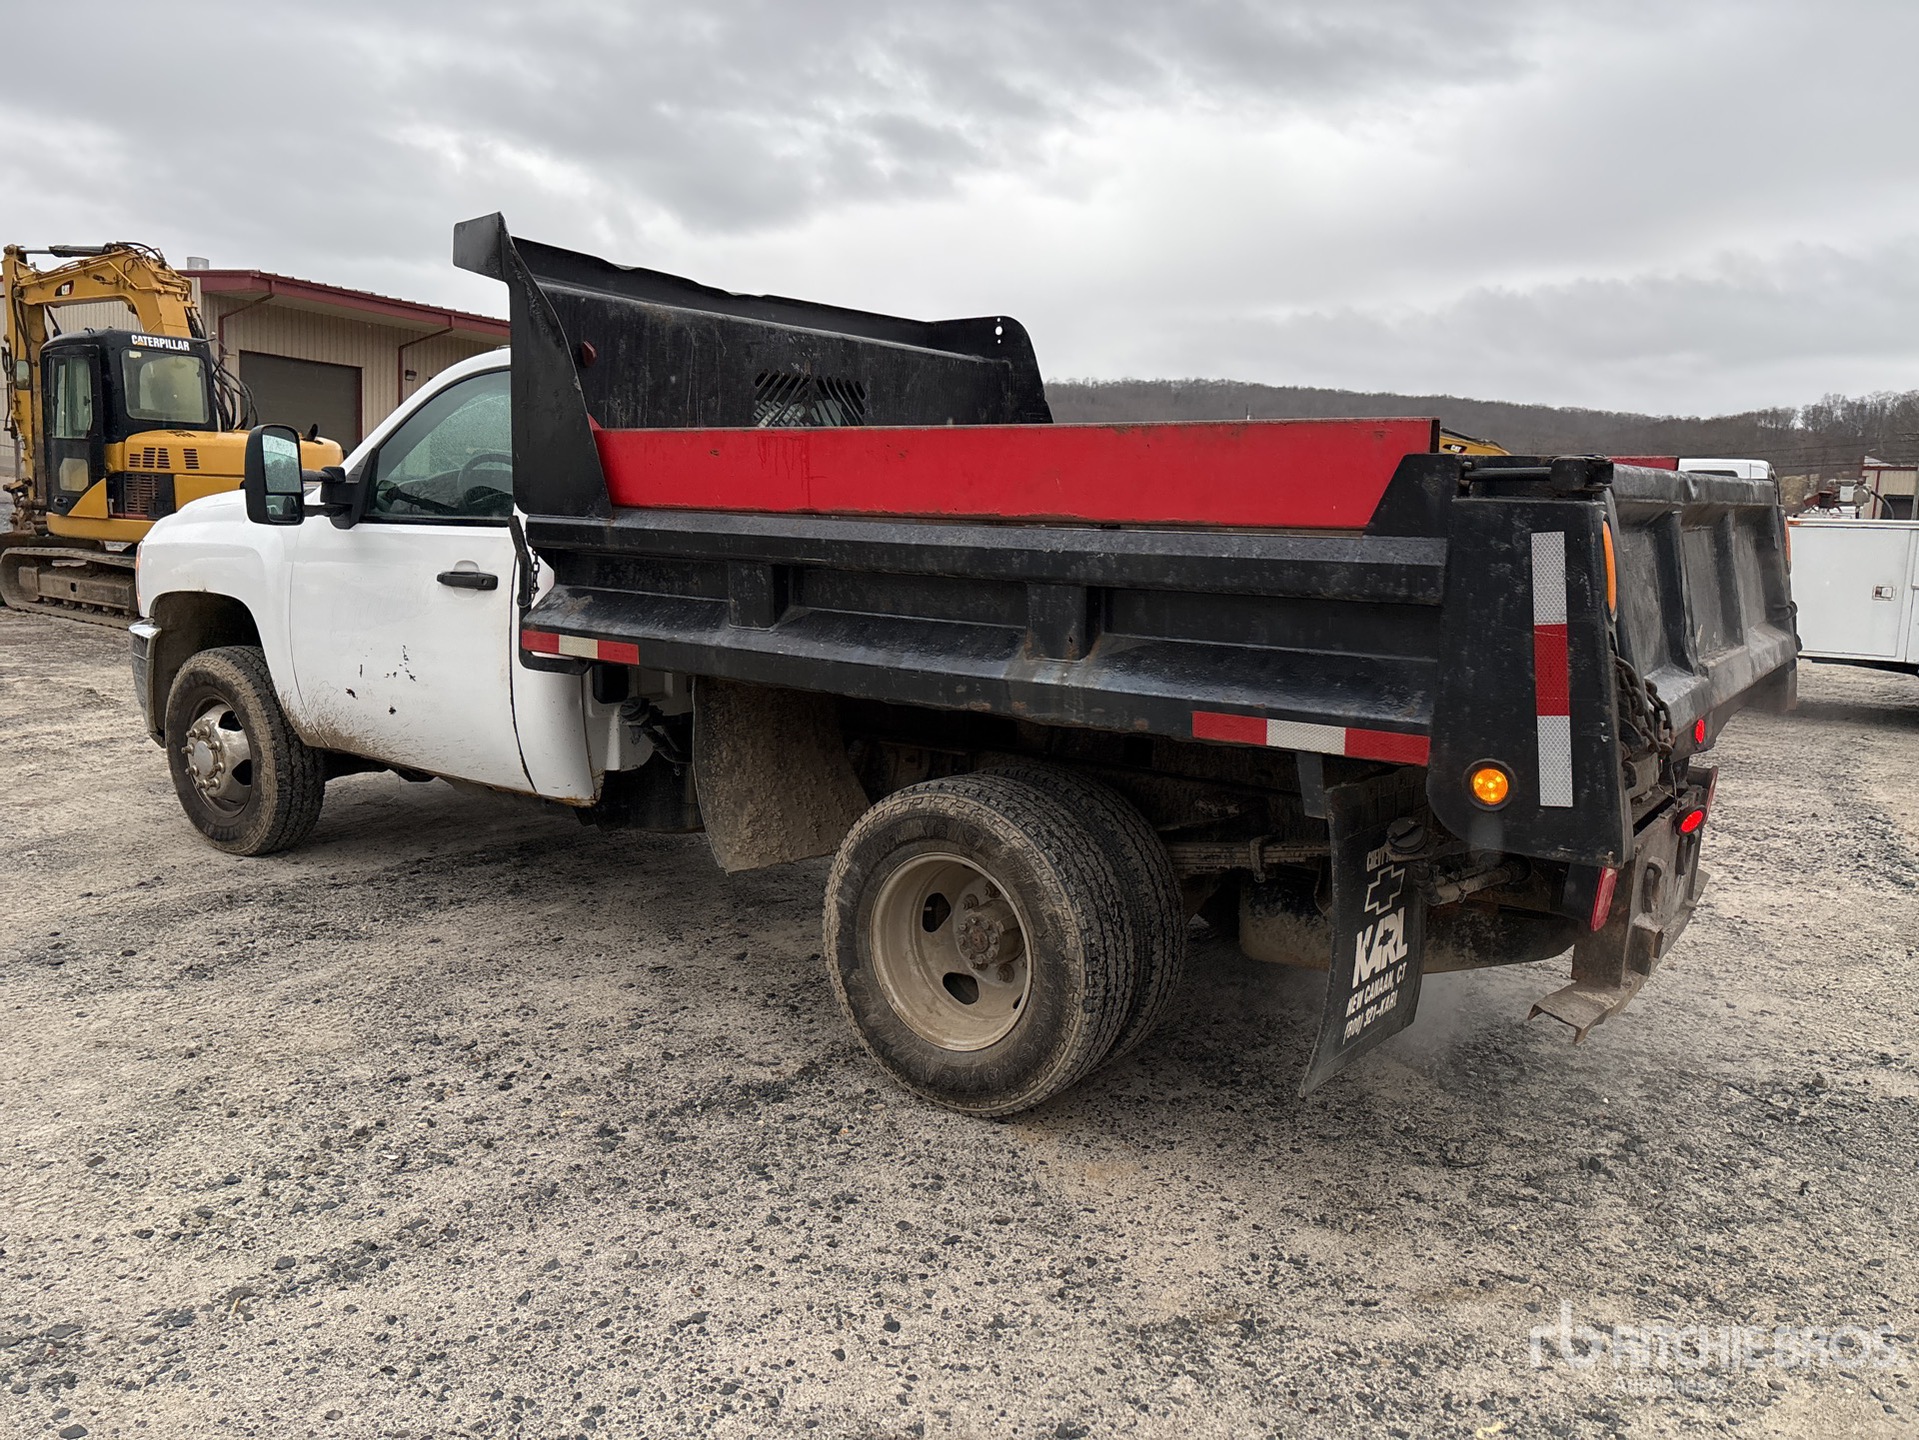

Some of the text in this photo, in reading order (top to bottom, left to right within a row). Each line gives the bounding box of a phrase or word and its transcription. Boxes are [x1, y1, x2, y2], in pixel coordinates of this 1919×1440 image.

[131, 334, 190, 351] CATERPILLAR
[1352, 906, 1408, 989] KARL
[1345, 988, 1365, 1018] NEW
[1396, 961, 1408, 984] CT
